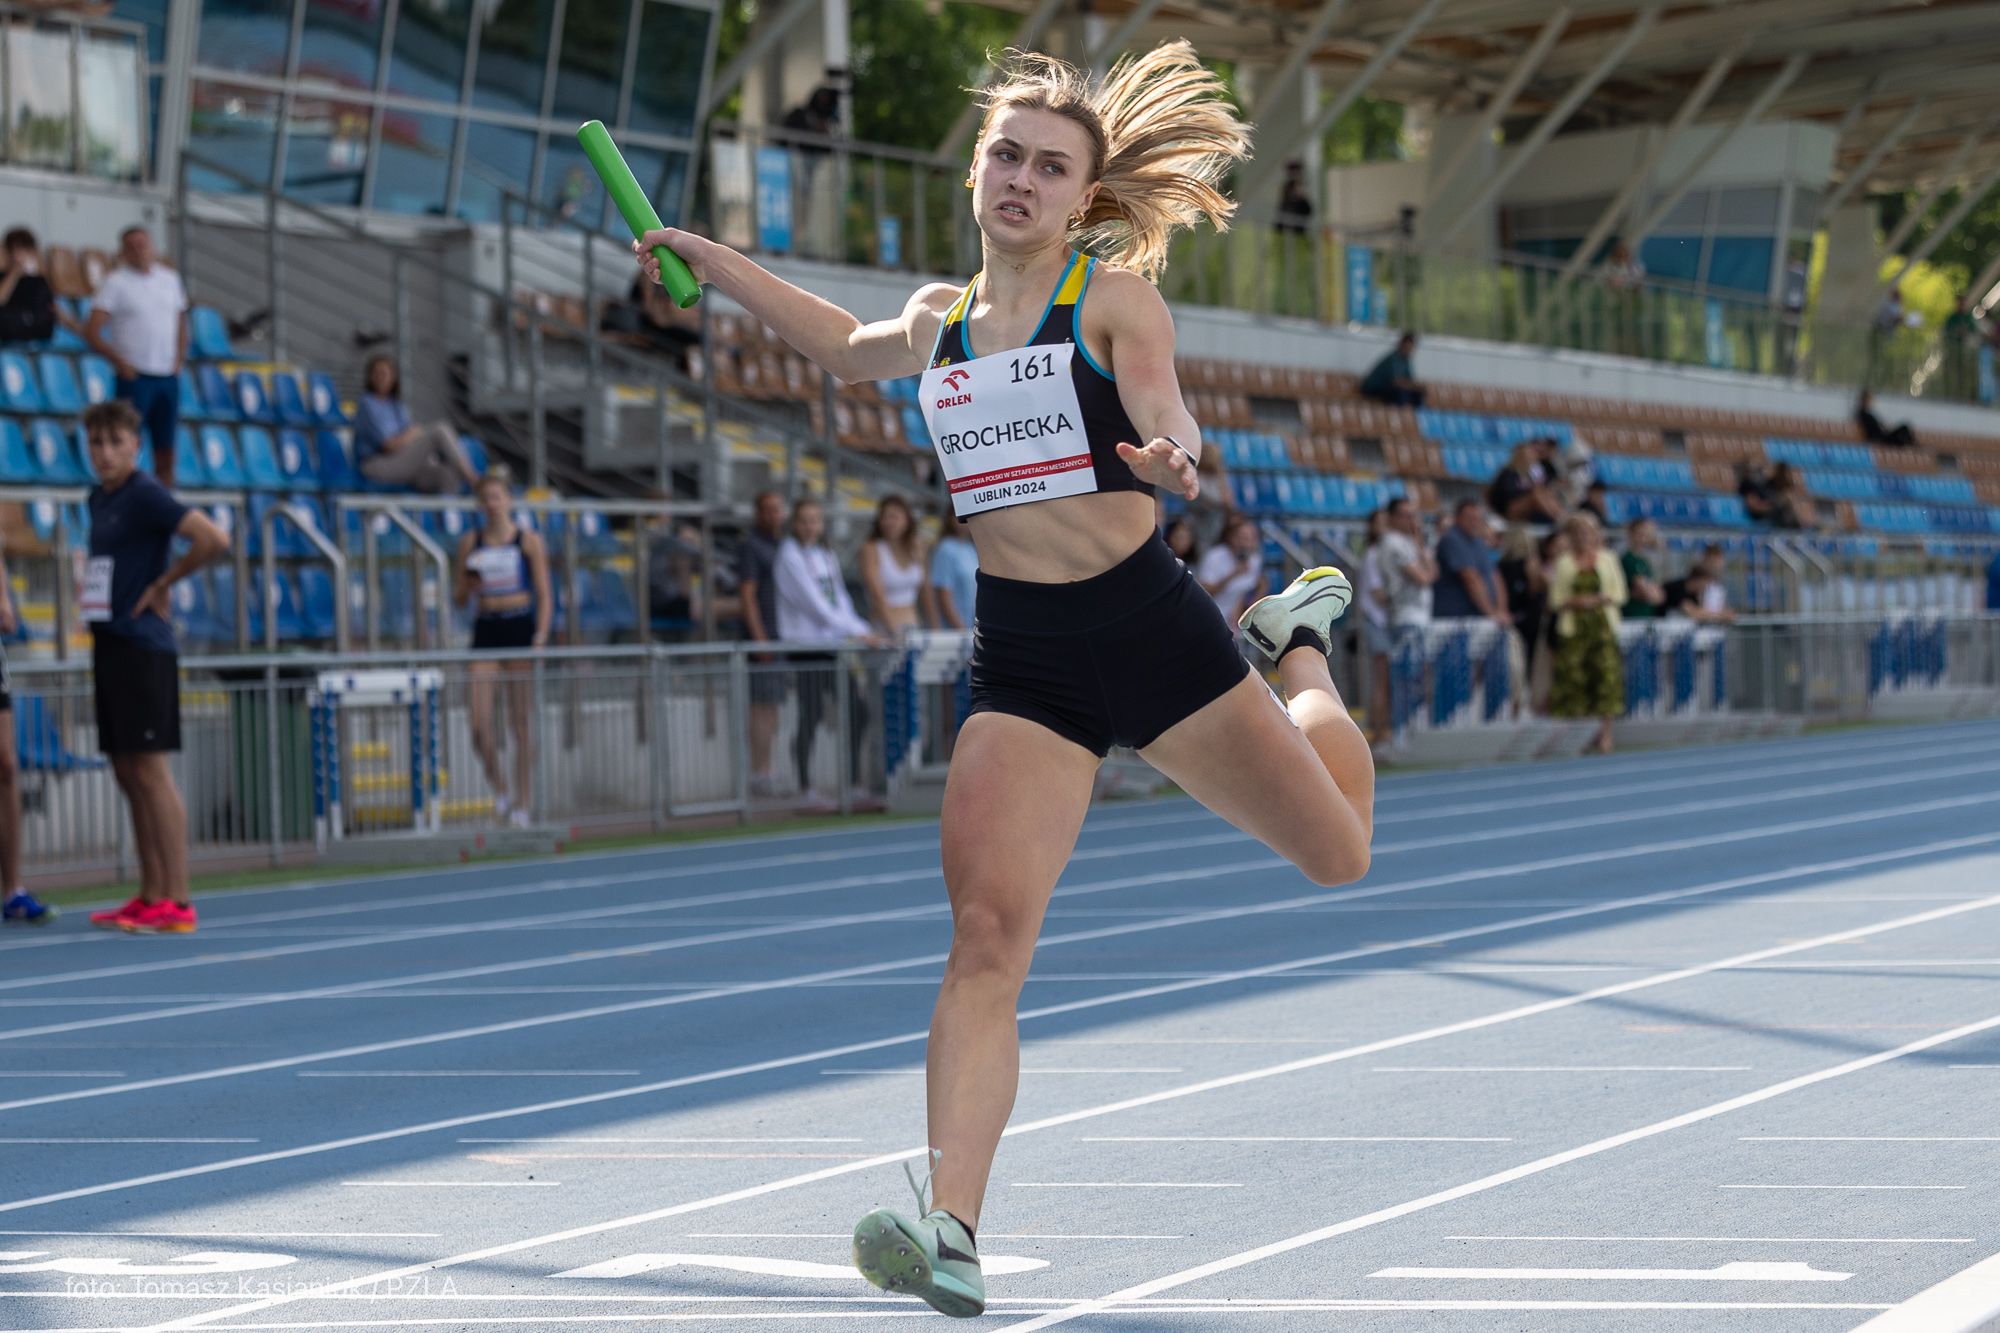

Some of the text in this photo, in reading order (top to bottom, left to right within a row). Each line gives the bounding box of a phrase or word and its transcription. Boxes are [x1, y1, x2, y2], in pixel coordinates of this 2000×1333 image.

[1010, 353, 1055, 383] 161
[937, 393, 972, 409] ORLEN
[940, 412, 1074, 455] GROCHECKA
[985, 474, 1003, 482] POLSKI
[1010, 466, 1048, 477] SZTAFETACH
[973, 480, 1047, 504] LUBLIN 2024
